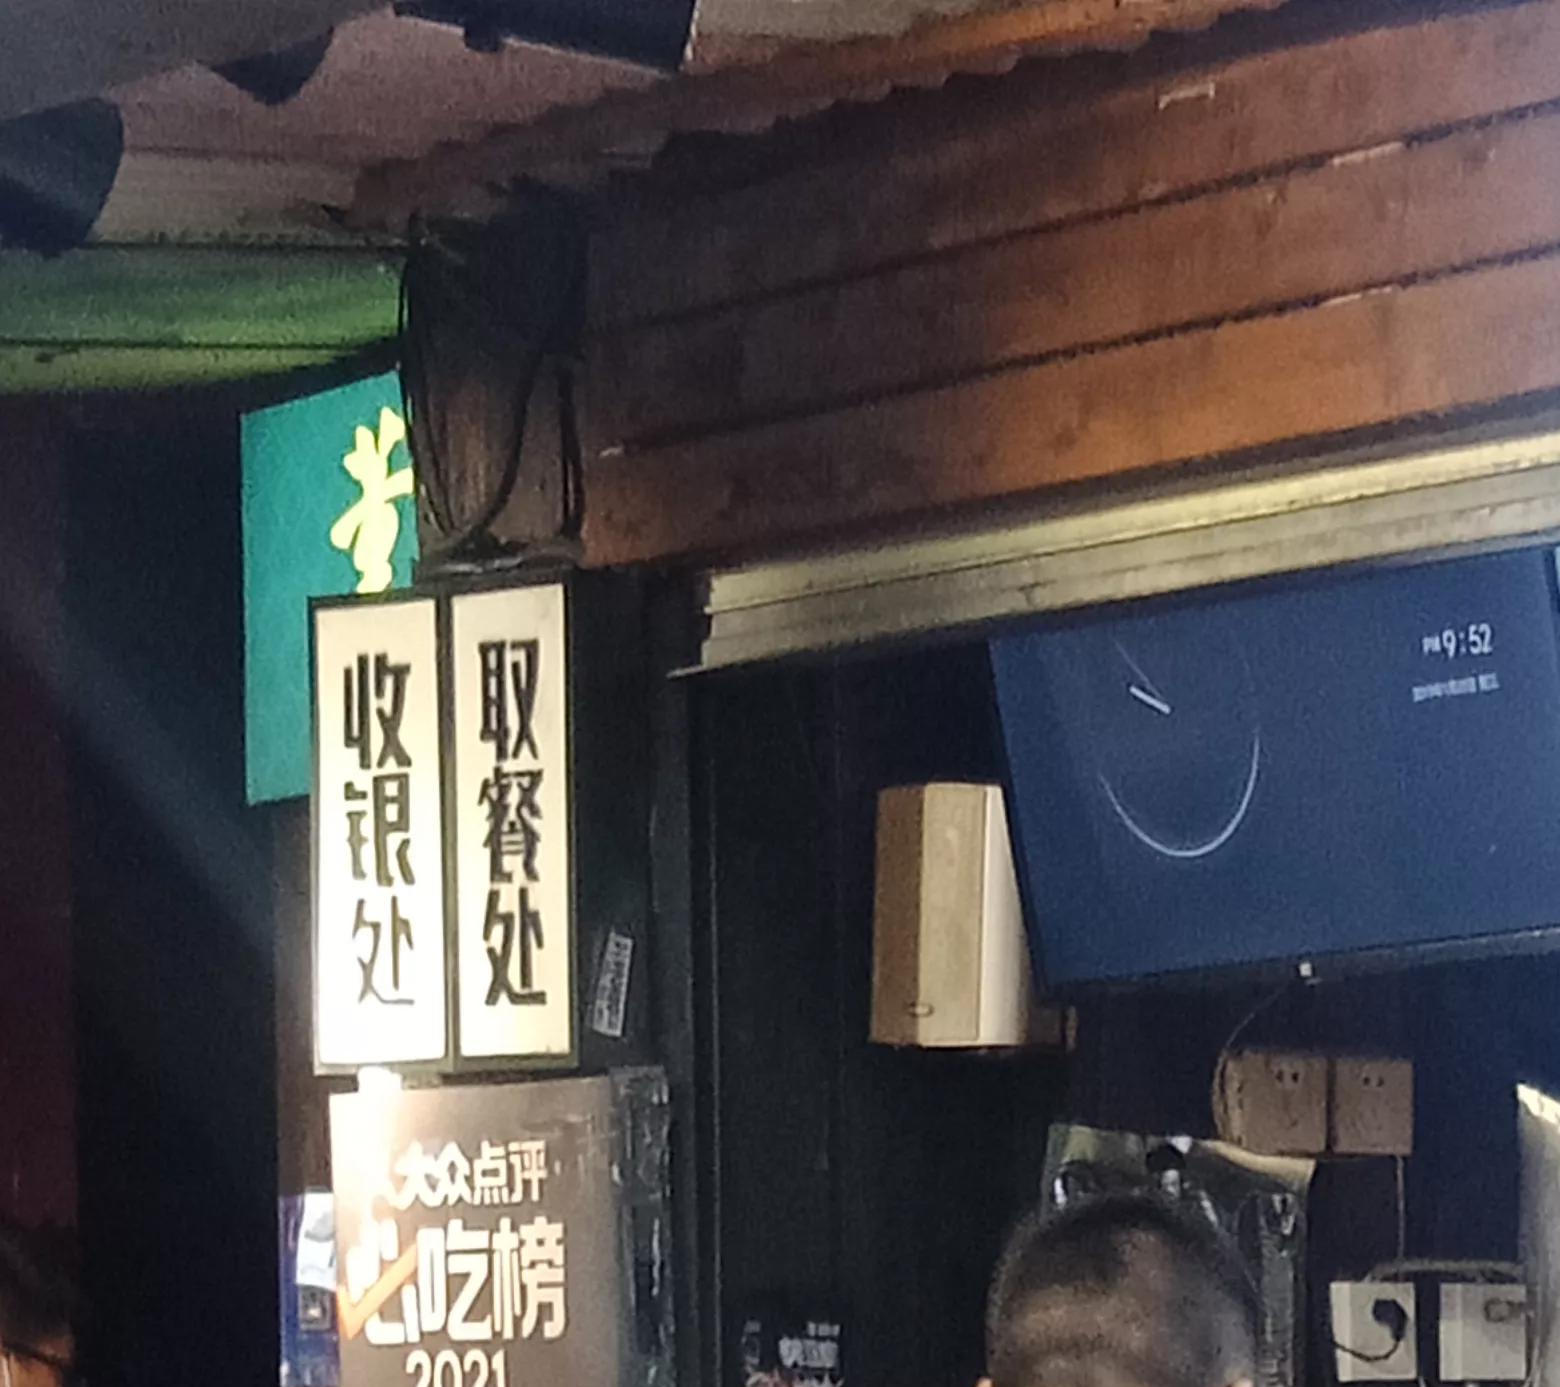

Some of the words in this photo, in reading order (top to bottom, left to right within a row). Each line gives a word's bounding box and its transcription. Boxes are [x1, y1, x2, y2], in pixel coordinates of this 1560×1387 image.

[1442, 623, 1493, 659] 9:52
[343, 652, 415, 1006] 收银处
[477, 638, 548, 1007] 取餐处
[396, 1140, 548, 1209] 大众点评
